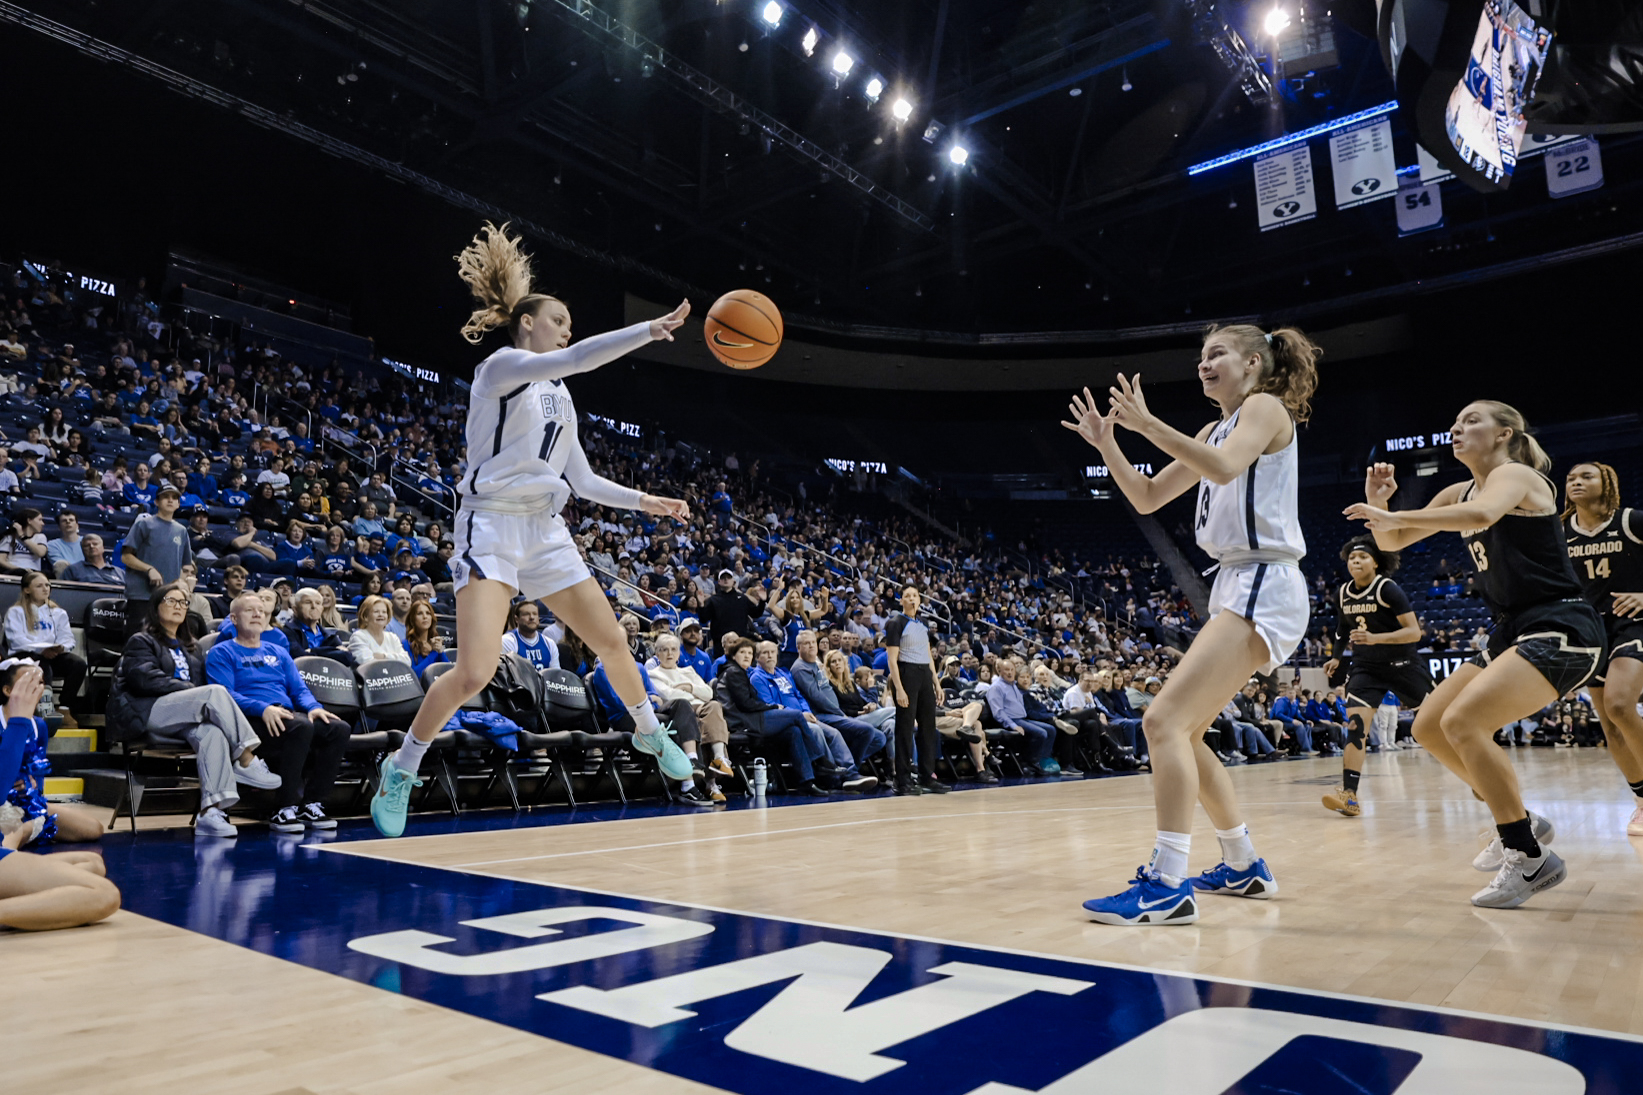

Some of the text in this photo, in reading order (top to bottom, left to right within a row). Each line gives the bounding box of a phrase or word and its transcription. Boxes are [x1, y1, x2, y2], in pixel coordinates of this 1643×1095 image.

[1556, 155, 1590, 178] 22
[1405, 191, 1432, 210] 54
[80, 275, 116, 297] PIZZA
[416, 366, 440, 384] PIZZA
[540, 393, 572, 423] BYU
[1385, 435, 1426, 452] NICO'S
[1468, 541, 1489, 573] 13
[1567, 540, 1622, 558] COLORADO
[1583, 557, 1612, 580] 14
[1342, 603, 1378, 615] COLORADO
[1355, 615, 1368, 631] 3
[525, 649, 543, 661] BYU
[298, 670, 353, 688] SAPPHIRE
[365, 673, 414, 688] SAPPHIRE
[545, 680, 586, 695] SAPPHIRE
